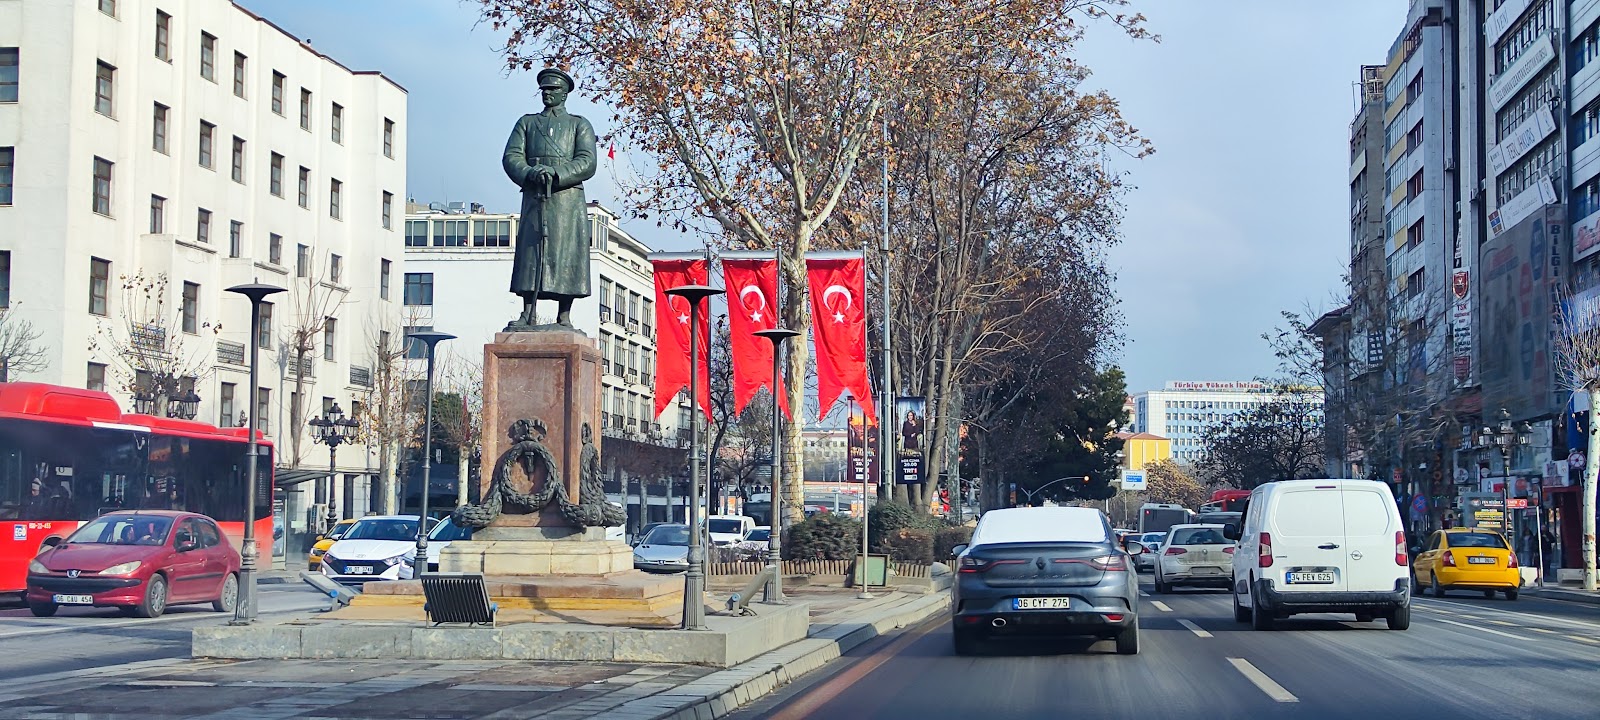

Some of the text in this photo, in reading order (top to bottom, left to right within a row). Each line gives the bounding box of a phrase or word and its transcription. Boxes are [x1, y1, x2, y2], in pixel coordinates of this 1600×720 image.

[1174, 381, 1203, 389] Türkiye
[1018, 599, 1068, 607] 06 CYF 275
